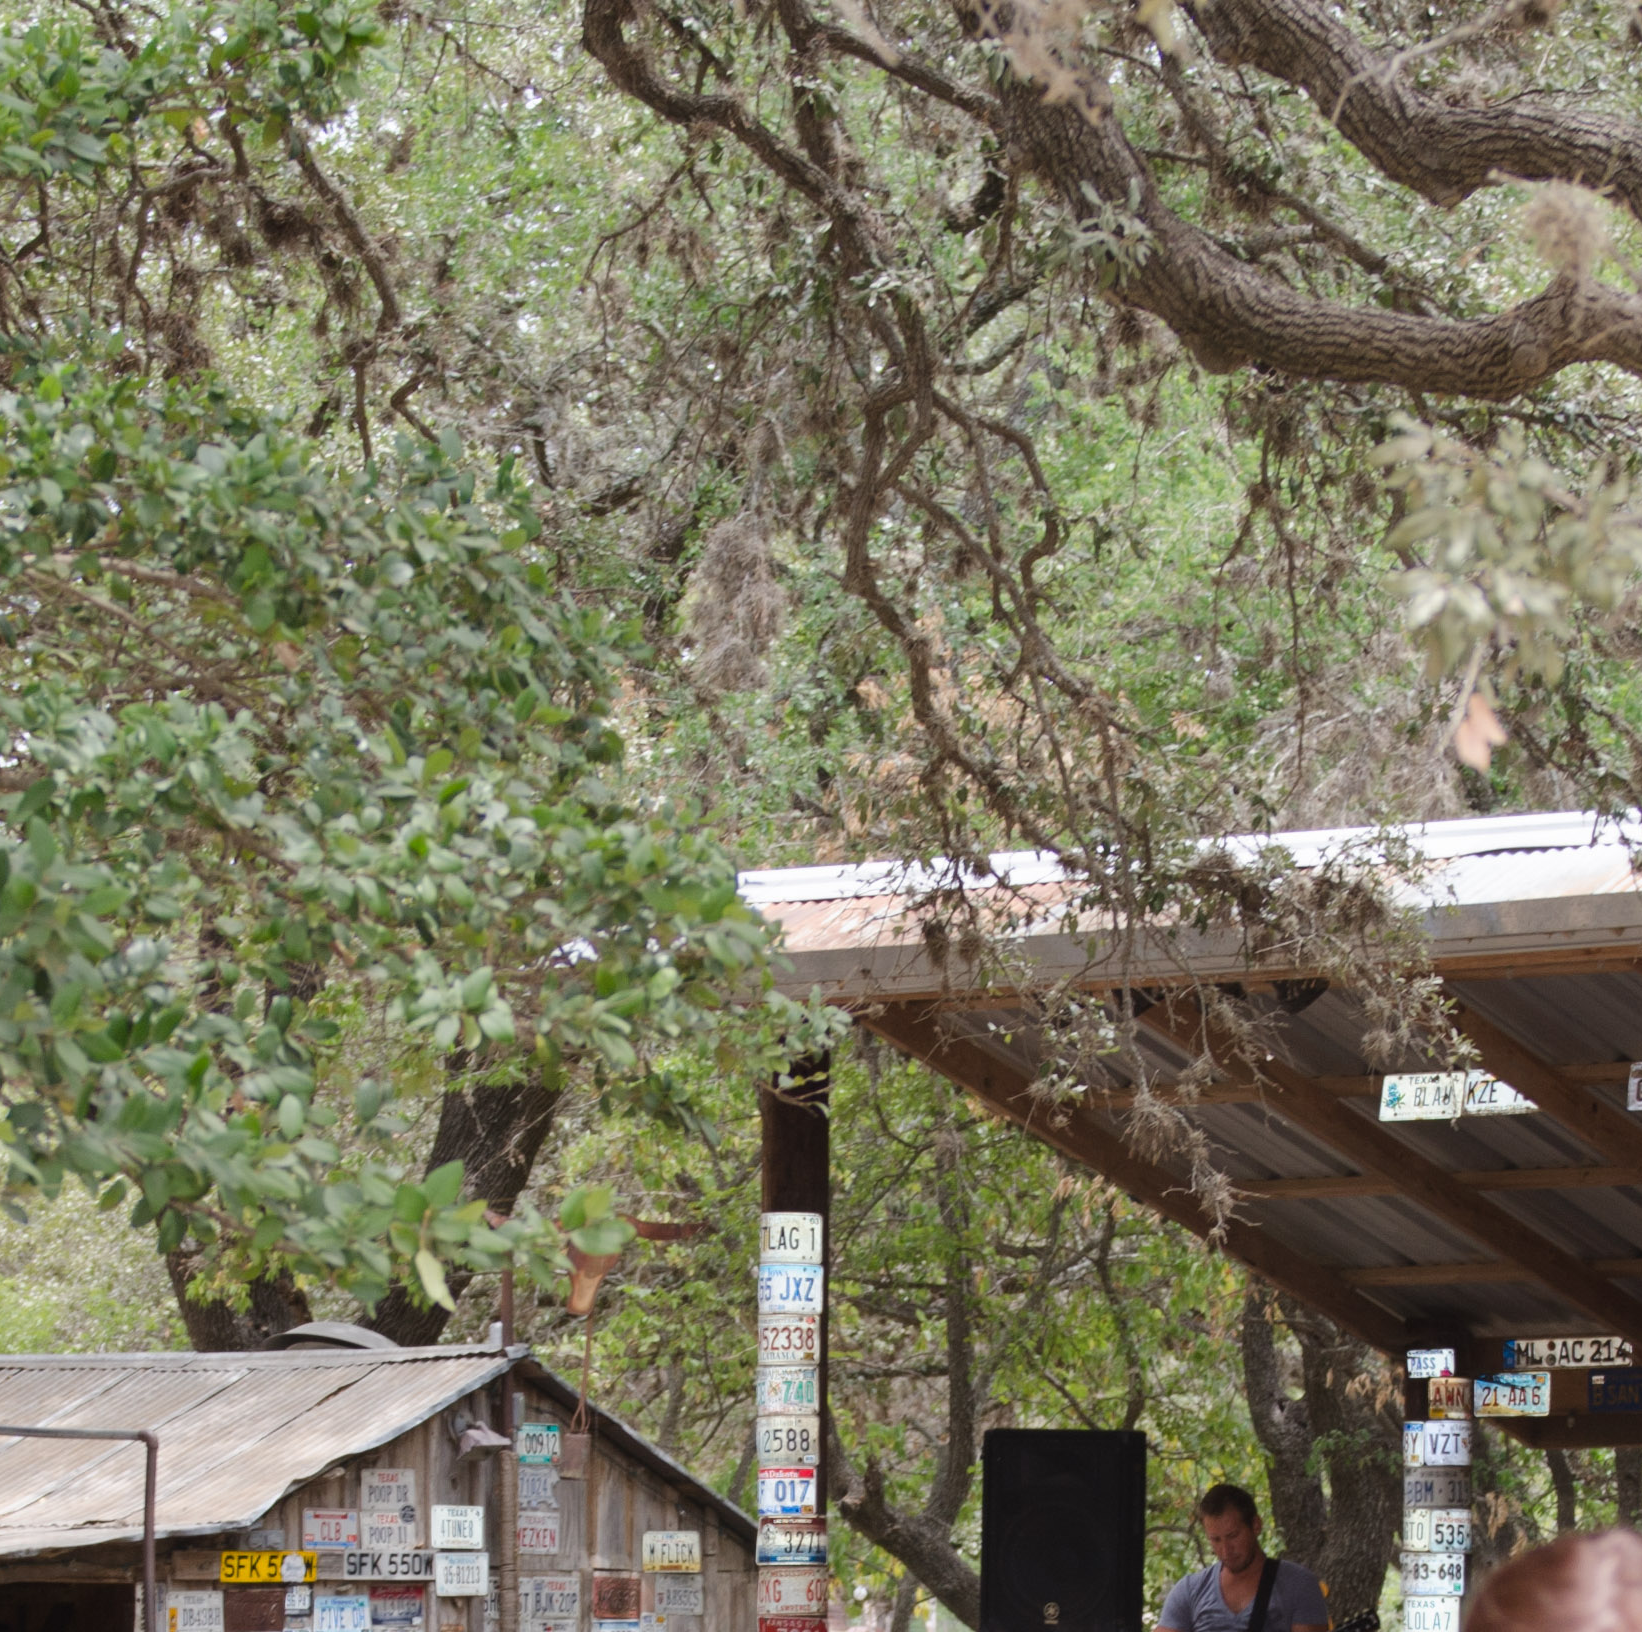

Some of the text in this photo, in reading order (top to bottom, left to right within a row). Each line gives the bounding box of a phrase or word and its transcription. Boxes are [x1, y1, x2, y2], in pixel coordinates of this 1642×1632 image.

[779, 1276, 815, 1302] JXZ
[1516, 1342, 1543, 1366] ML
[1558, 1341, 1584, 1363] AC
[1410, 1357, 1436, 1371] PASS
[378, 1473, 399, 1483] TEXAS
[368, 1486, 392, 1504] POOP
[774, 1480, 810, 1502] 017
[377, 1514, 399, 1525] TEXAS
[447, 1508, 468, 1517] TEXAS
[320, 1521, 342, 1542] CLB
[369, 1526, 392, 1545] POOP
[661, 1542, 695, 1564] FLICK
[223, 1554, 261, 1579] SFK
[346, 1552, 384, 1576] SFK
[388, 1551, 434, 1576] 550W
[1408, 1600, 1435, 1609] TEXAS
[319, 1608, 347, 1630] FIVE
[1407, 1611, 1451, 1631] LOLA7
